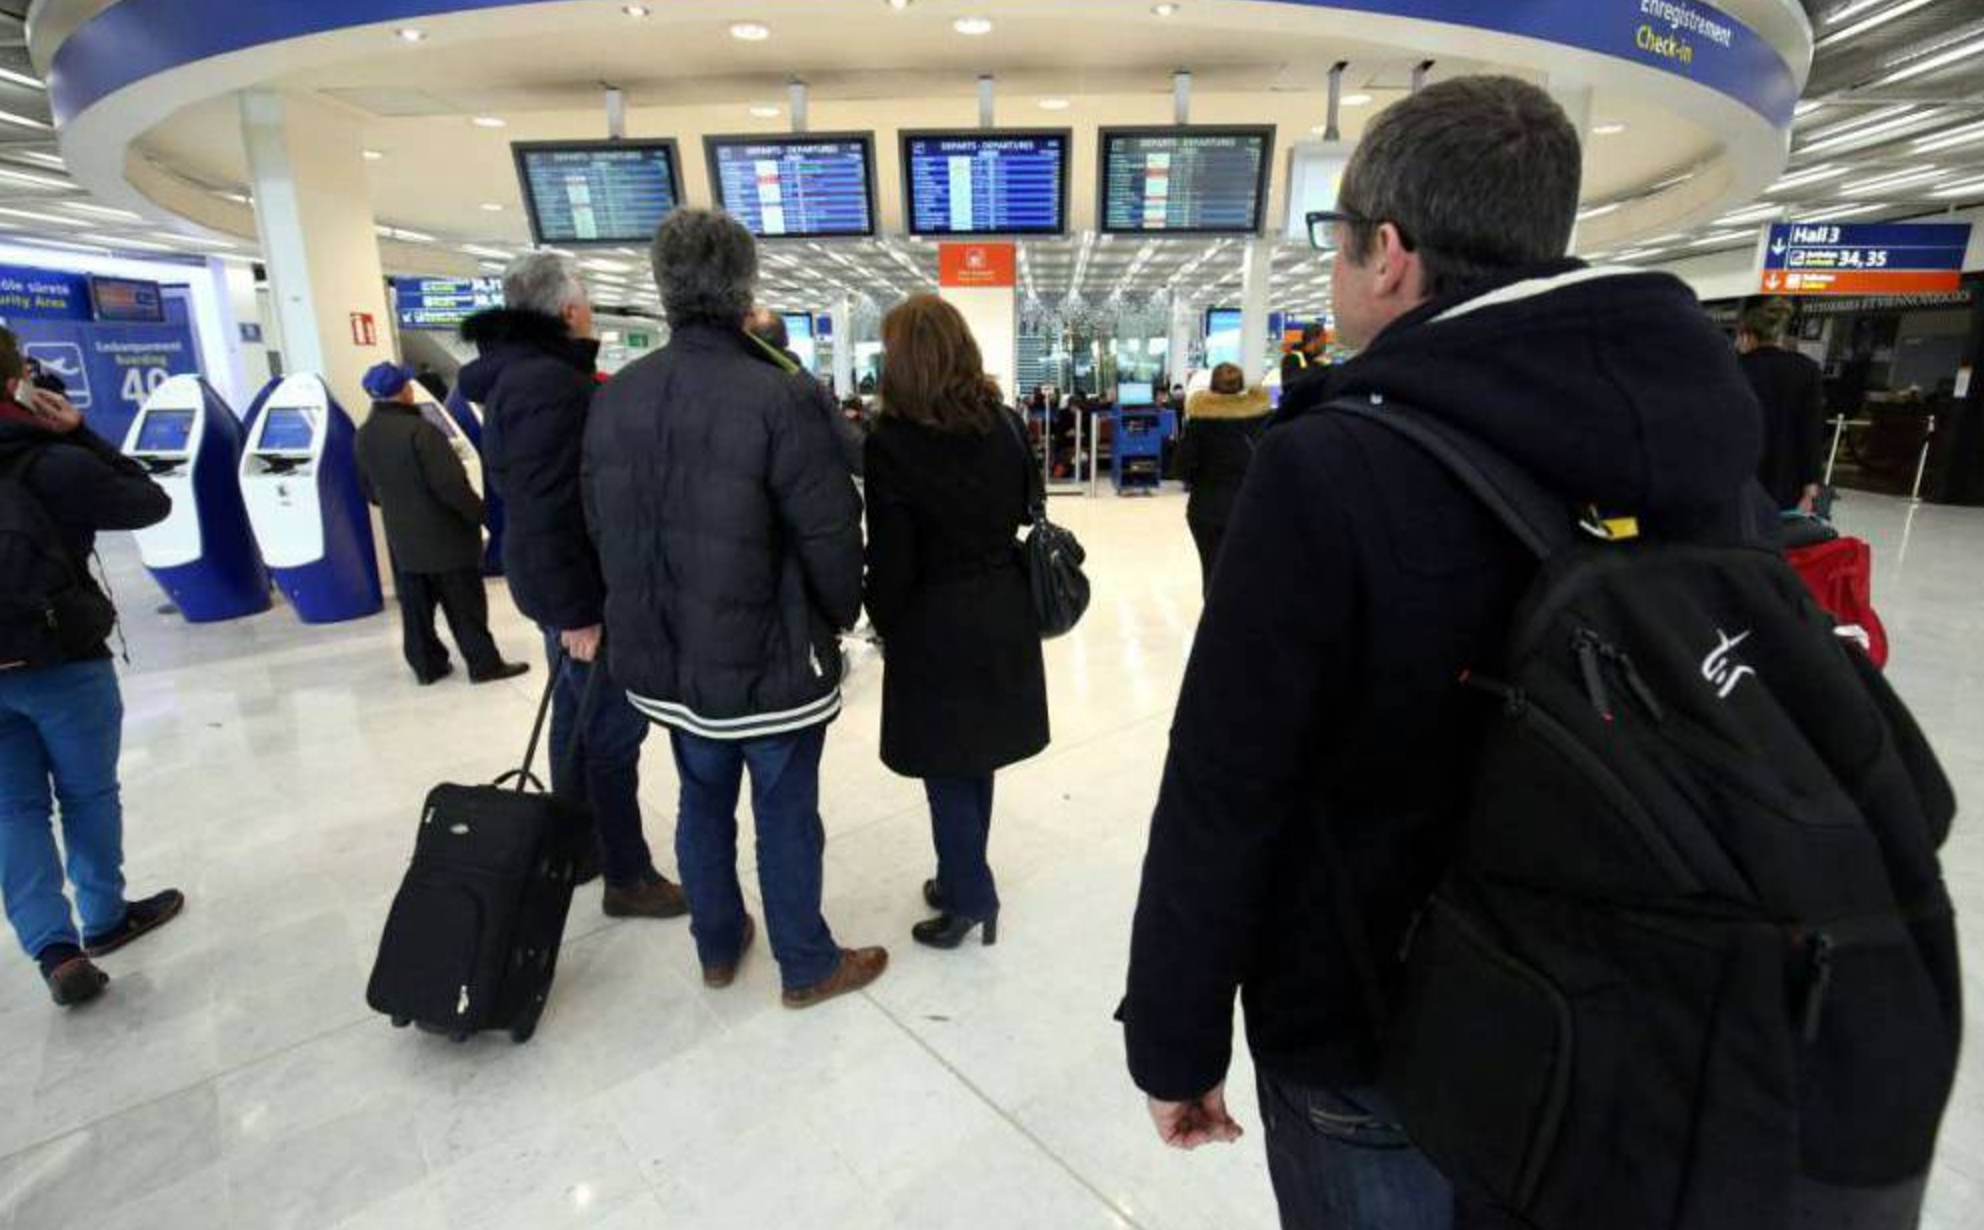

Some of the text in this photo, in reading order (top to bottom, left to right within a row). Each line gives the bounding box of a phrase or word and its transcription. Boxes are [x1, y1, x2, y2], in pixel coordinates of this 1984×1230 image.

[1637, 24, 1692, 62] Check-in
[1793, 225, 1841, 243] Hall 3
[1867, 251, 1887, 266] 35
